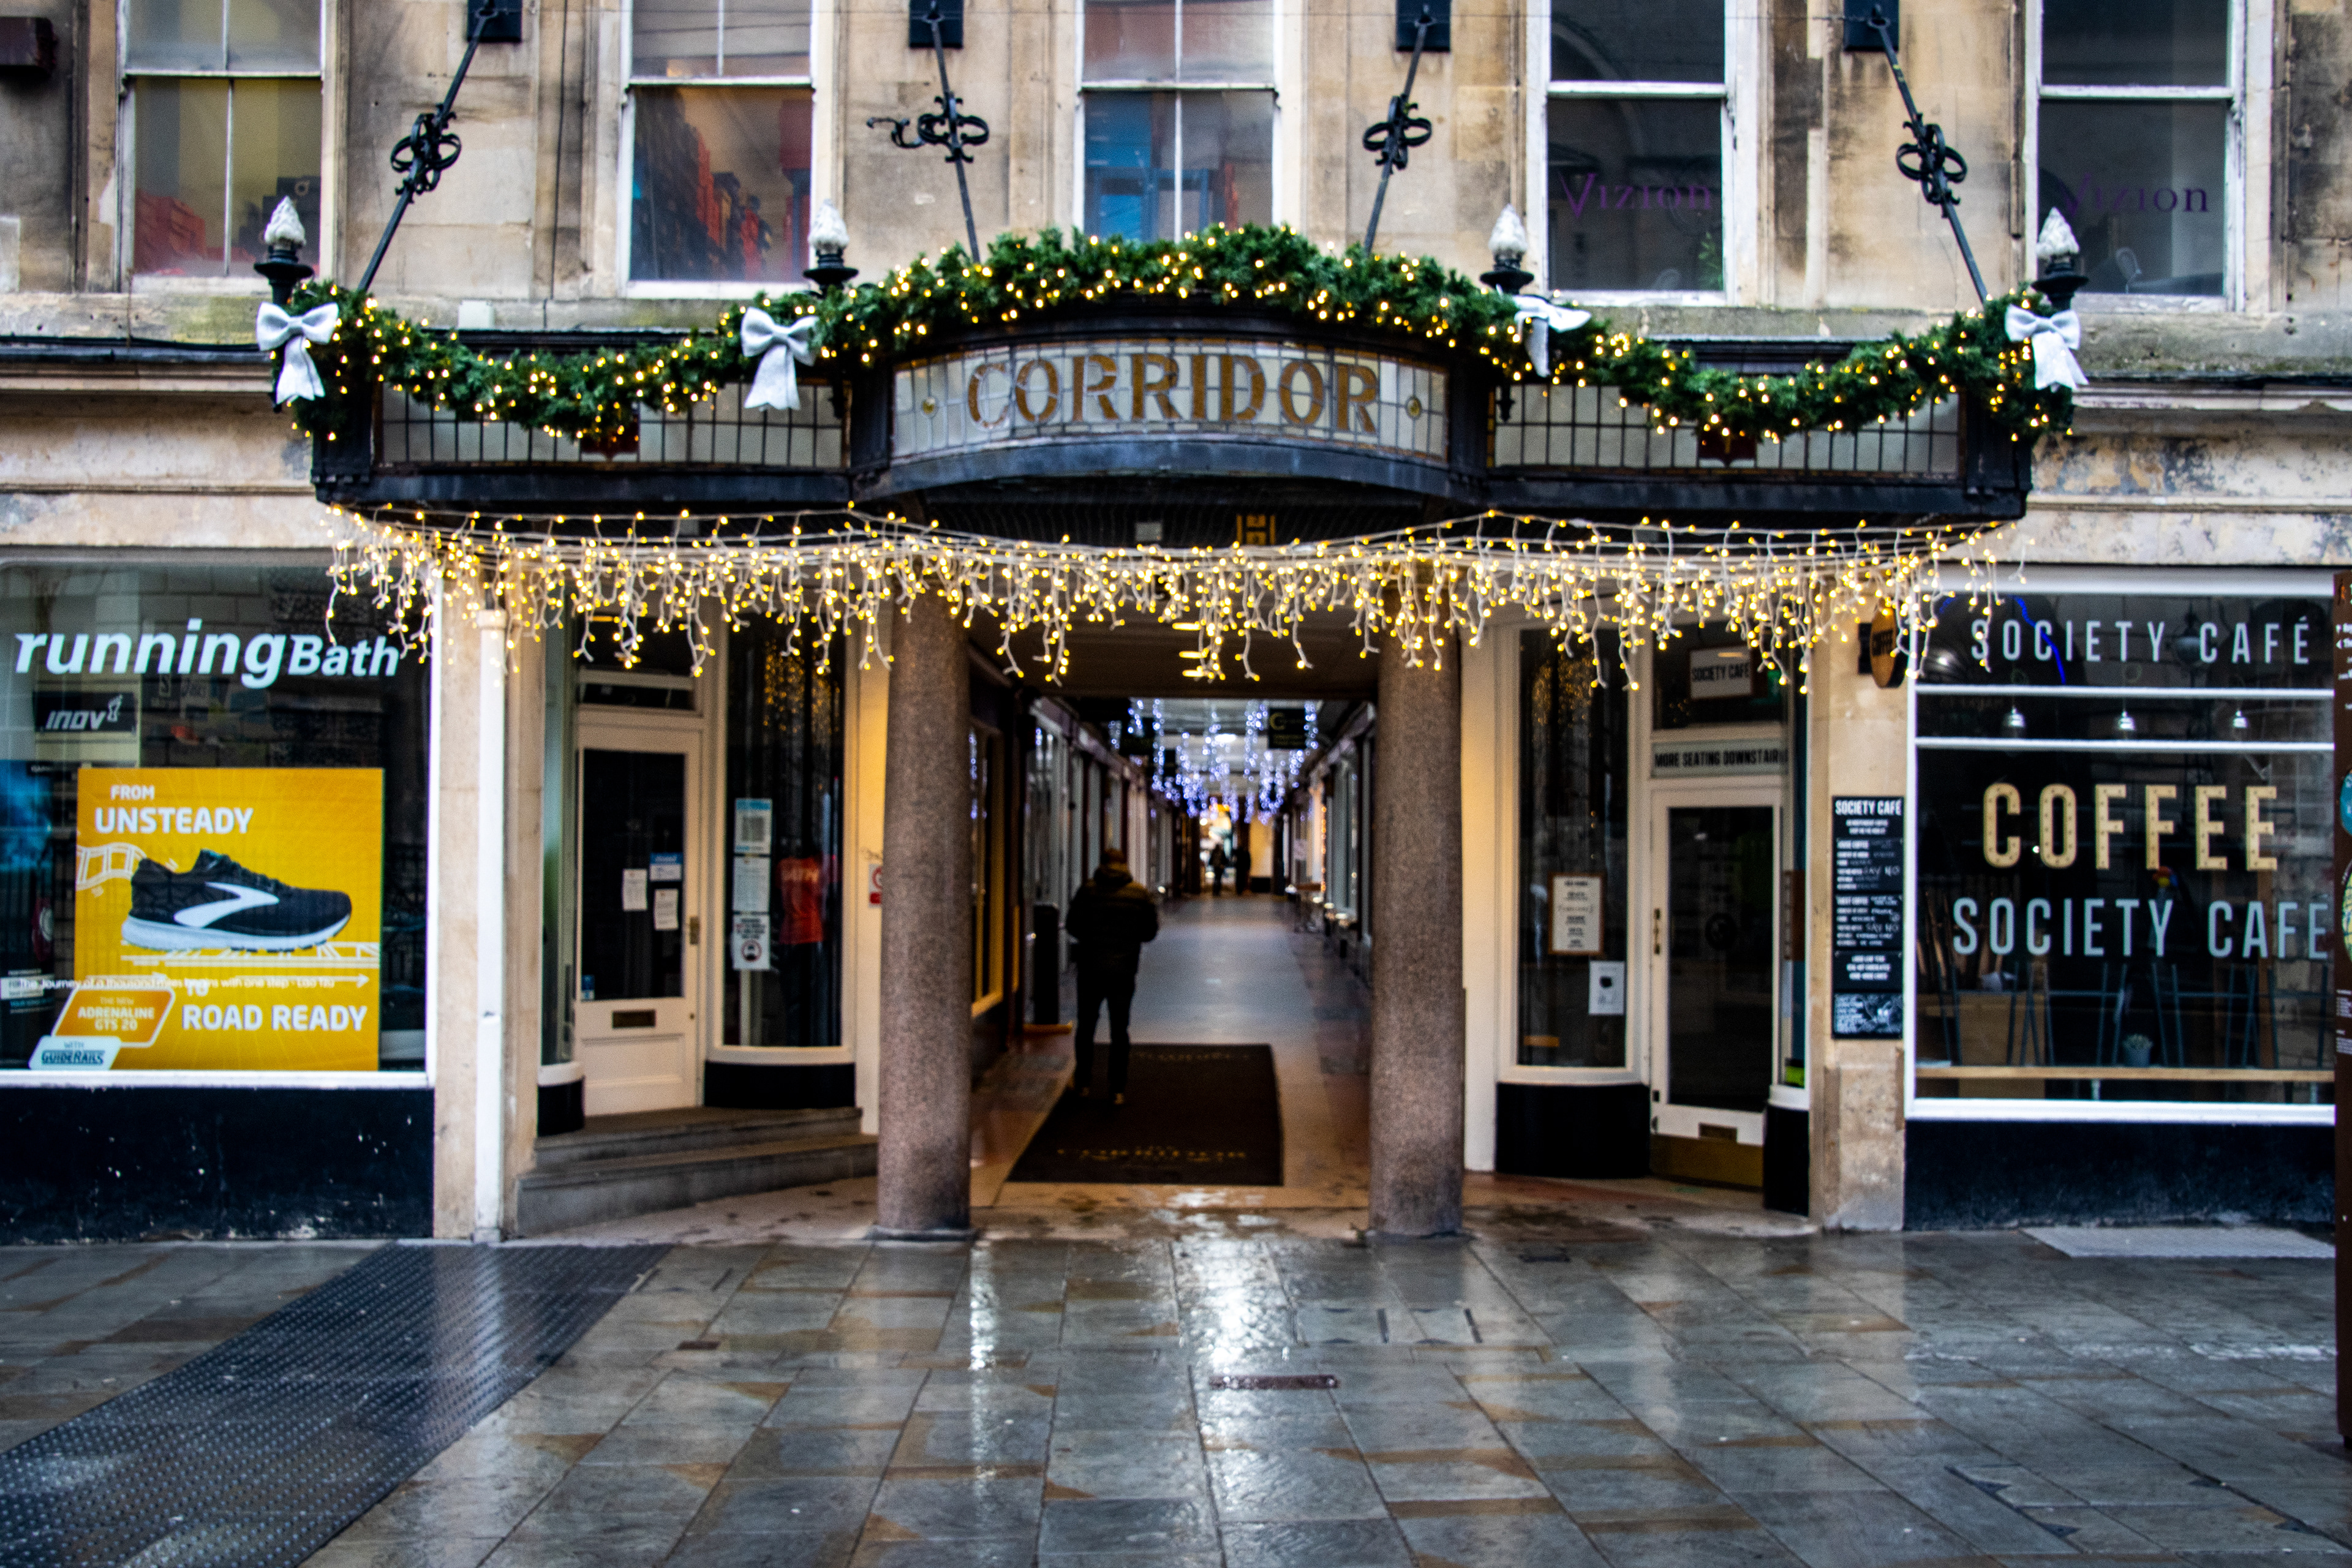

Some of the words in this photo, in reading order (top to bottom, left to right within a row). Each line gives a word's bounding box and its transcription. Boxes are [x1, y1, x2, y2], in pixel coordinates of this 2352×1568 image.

[967, 352, 1379, 434] CORRIDOR
[1970, 619, 2165, 663] SOCIETY
[2199, 616, 2310, 664] CAFÉ
[1654, 752, 1679, 766] MORE
[1682, 751, 1720, 766] SEATING
[110, 785, 155, 801] FROM
[94, 807, 254, 834] UNSTEADY
[1835, 799, 1875, 816] SOCIETY
[1983, 783, 2278, 871] COFFEE
[1953, 897, 2173, 957] SOCIETY
[2207, 900, 2329, 960] CAFE
[77, 1006, 155, 1020] ADRENALINE
[94, 1019, 118, 1031] GTS
[121, 1019, 138, 1031] 20
[182, 1005, 263, 1031] ROAD
[271, 1005, 368, 1031] READY
